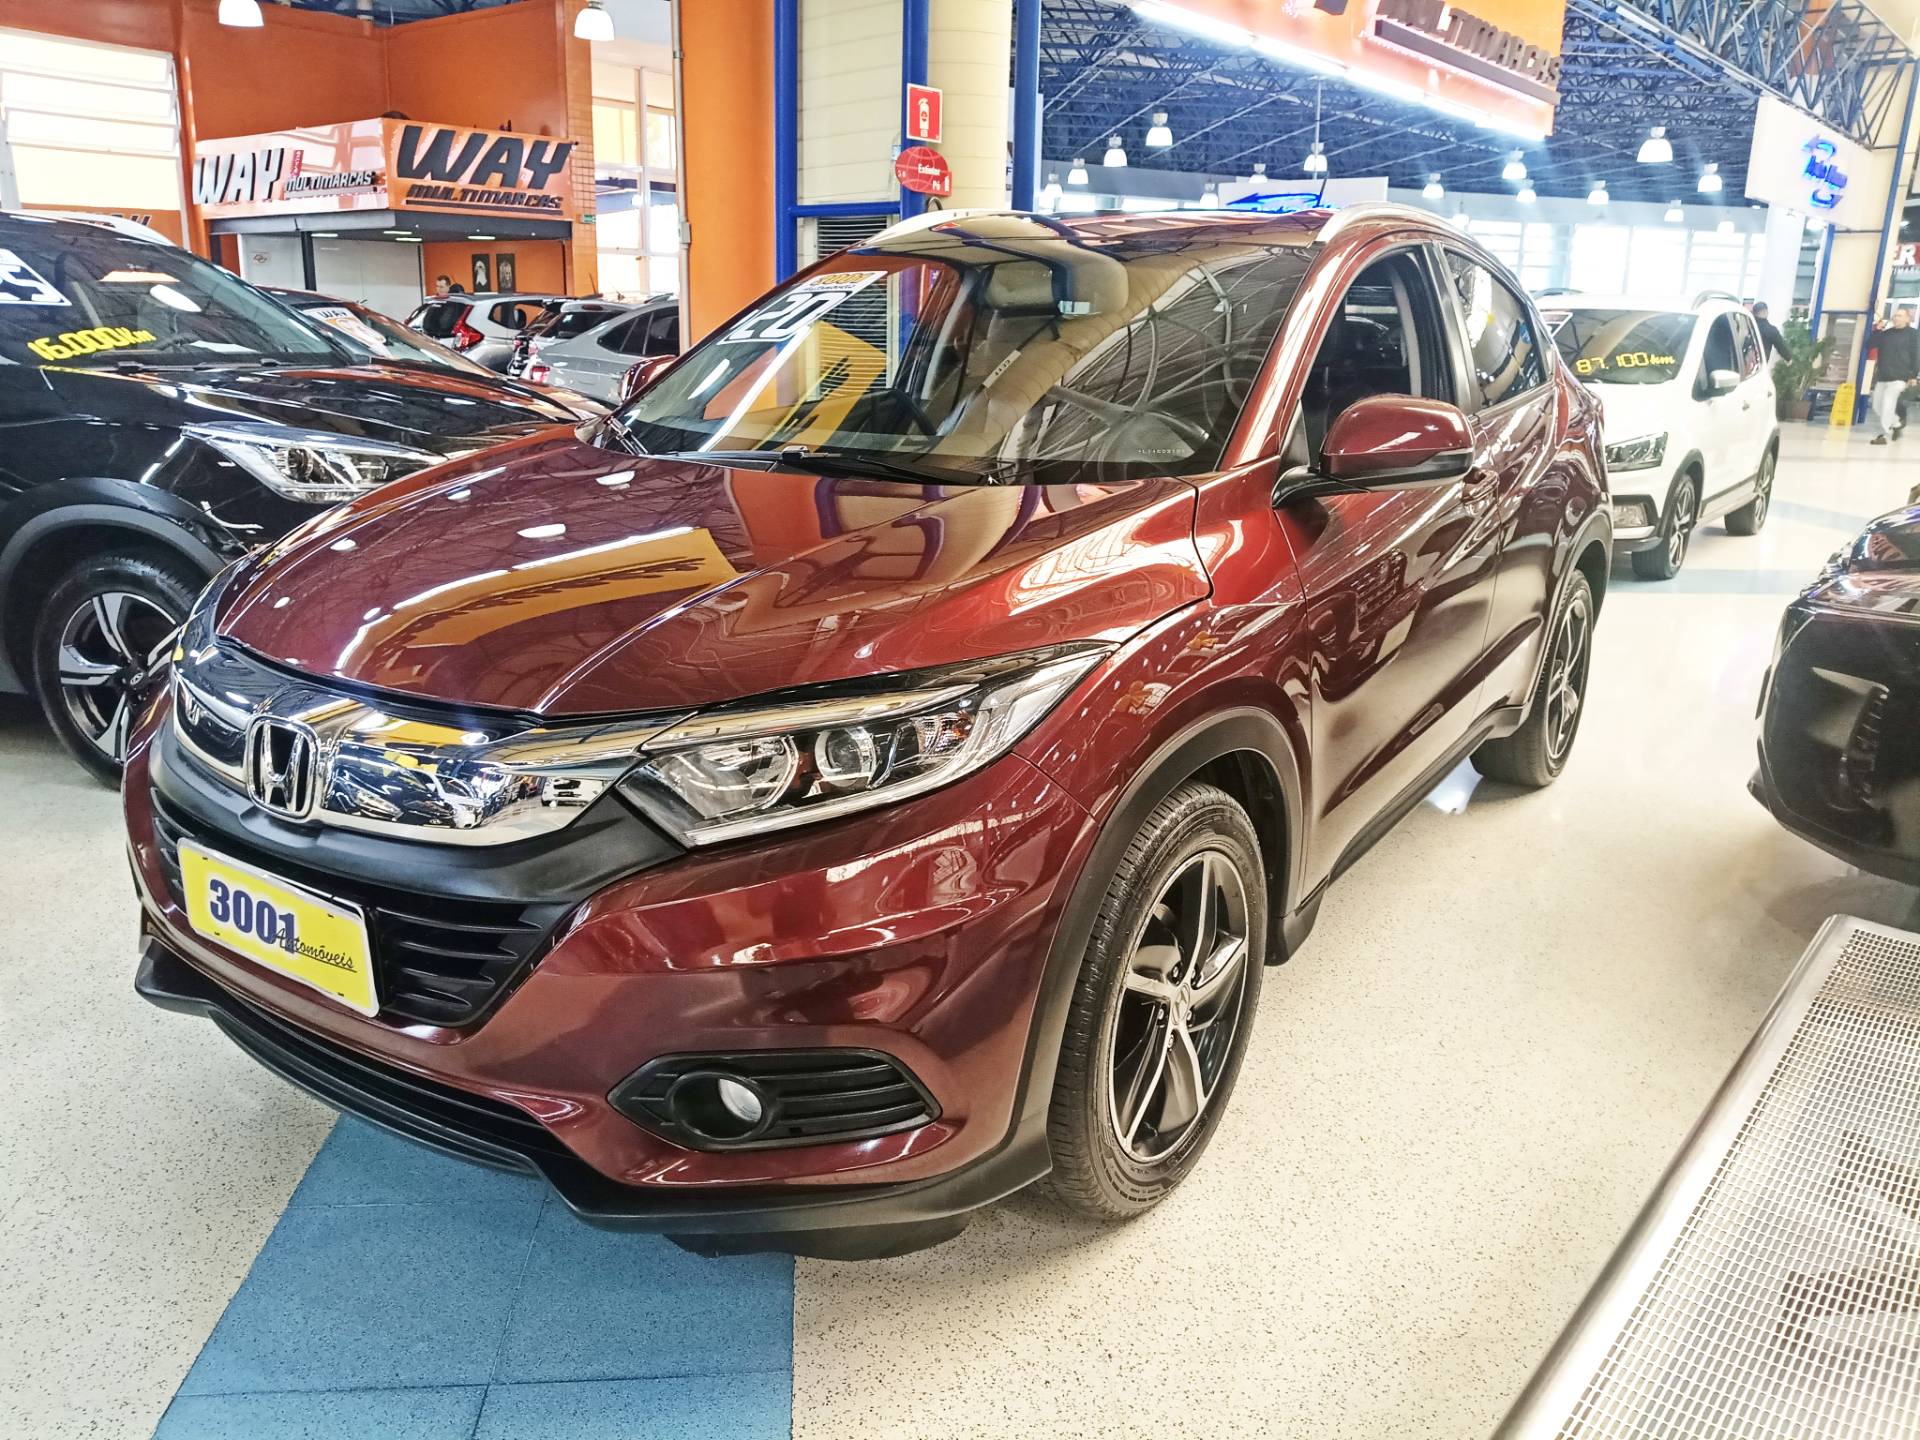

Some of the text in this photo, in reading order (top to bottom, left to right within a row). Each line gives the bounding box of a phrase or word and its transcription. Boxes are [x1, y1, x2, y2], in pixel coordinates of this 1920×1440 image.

[193, 148, 285, 204] WAY
[285, 171, 376, 192] MULTIMARCAS
[397, 125, 573, 190] WAY
[406, 184, 563, 209] MULTIMARCAS
[209, 879, 295, 954] 3001
